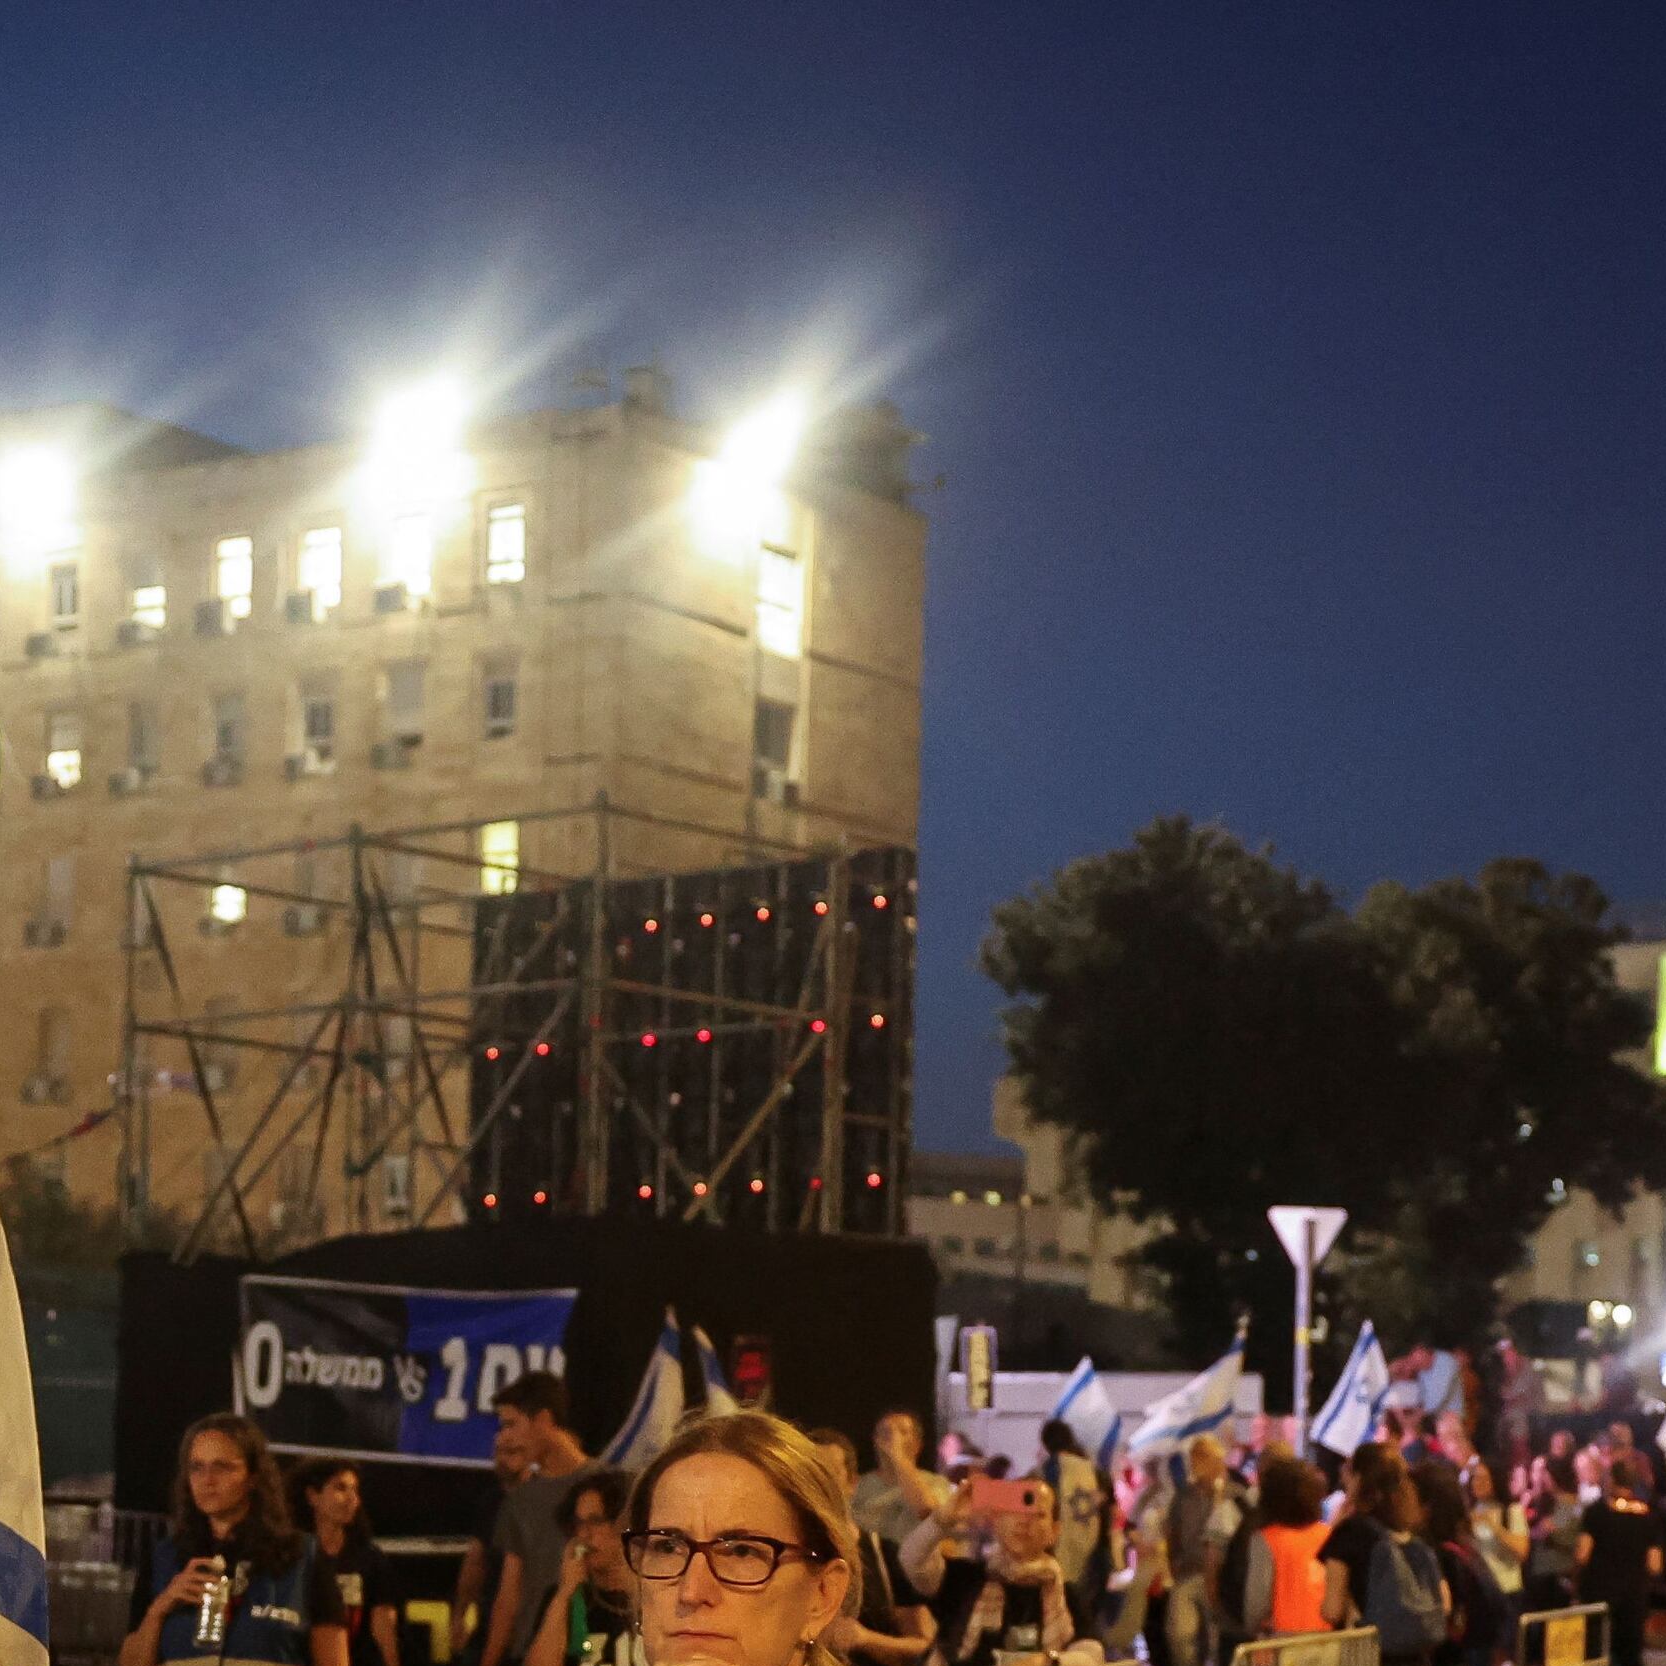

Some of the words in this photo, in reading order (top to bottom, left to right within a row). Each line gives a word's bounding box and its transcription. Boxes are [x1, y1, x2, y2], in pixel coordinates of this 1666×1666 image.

[243, 1320, 284, 1408] 0
[285, 1346, 385, 1390] ממשלה
[434, 1336, 468, 1421] 1
